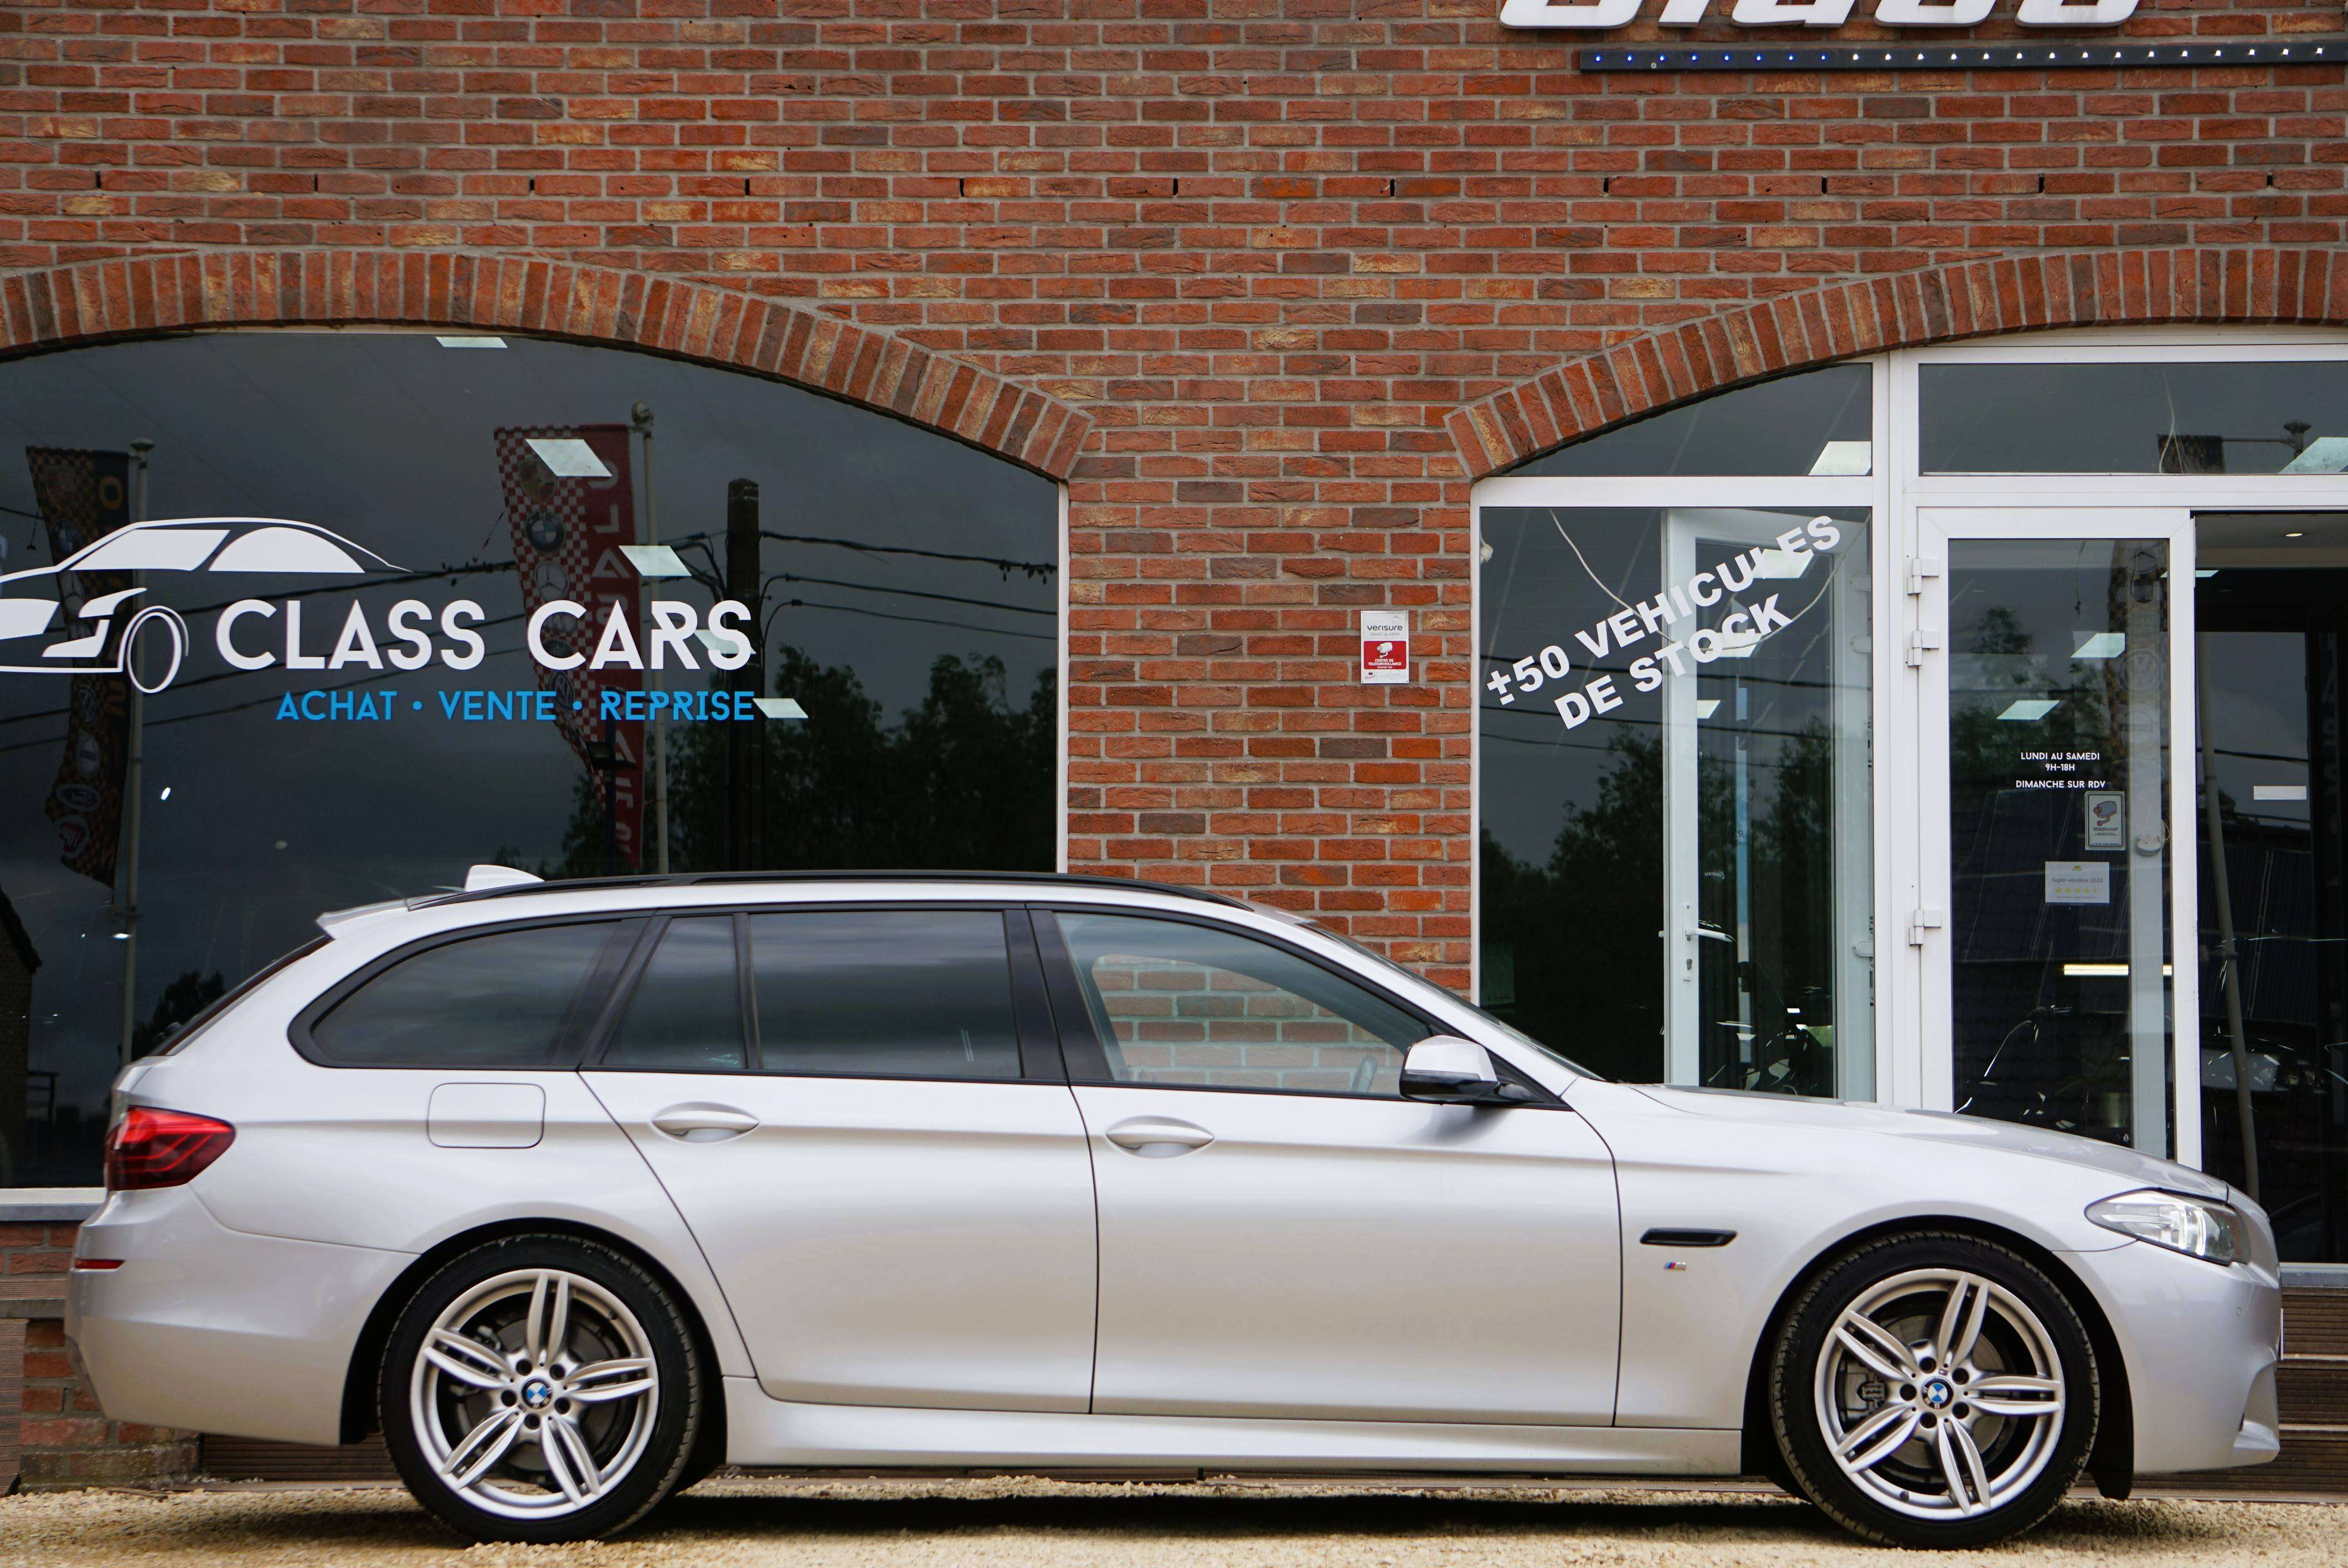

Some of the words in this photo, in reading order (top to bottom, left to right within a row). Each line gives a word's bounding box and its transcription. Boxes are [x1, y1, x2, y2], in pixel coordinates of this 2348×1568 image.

[1486, 644, 1571, 705] ±50
[1574, 515, 1841, 659] VEHICULES
[217, 599, 485, 670] CLASS
[528, 600, 751, 670] CARS
[1554, 674, 1624, 730] DE
[1629, 593, 1794, 693] STOCK
[276, 691, 398, 721] ACHAT
[438, 691, 557, 721] VENTE
[601, 691, 754, 721] REPRISE
[2021, 752, 2048, 760] LUNDI
[2051, 752, 2063, 760] AU
[2066, 752, 2099, 760] SAMEDI
[2045, 763, 2075, 771] 9H-18H
[2016, 780, 2064, 788] DIMANCHE
[2067, 780, 2085, 788] SUR
[2088, 780, 2105, 788] RDV
